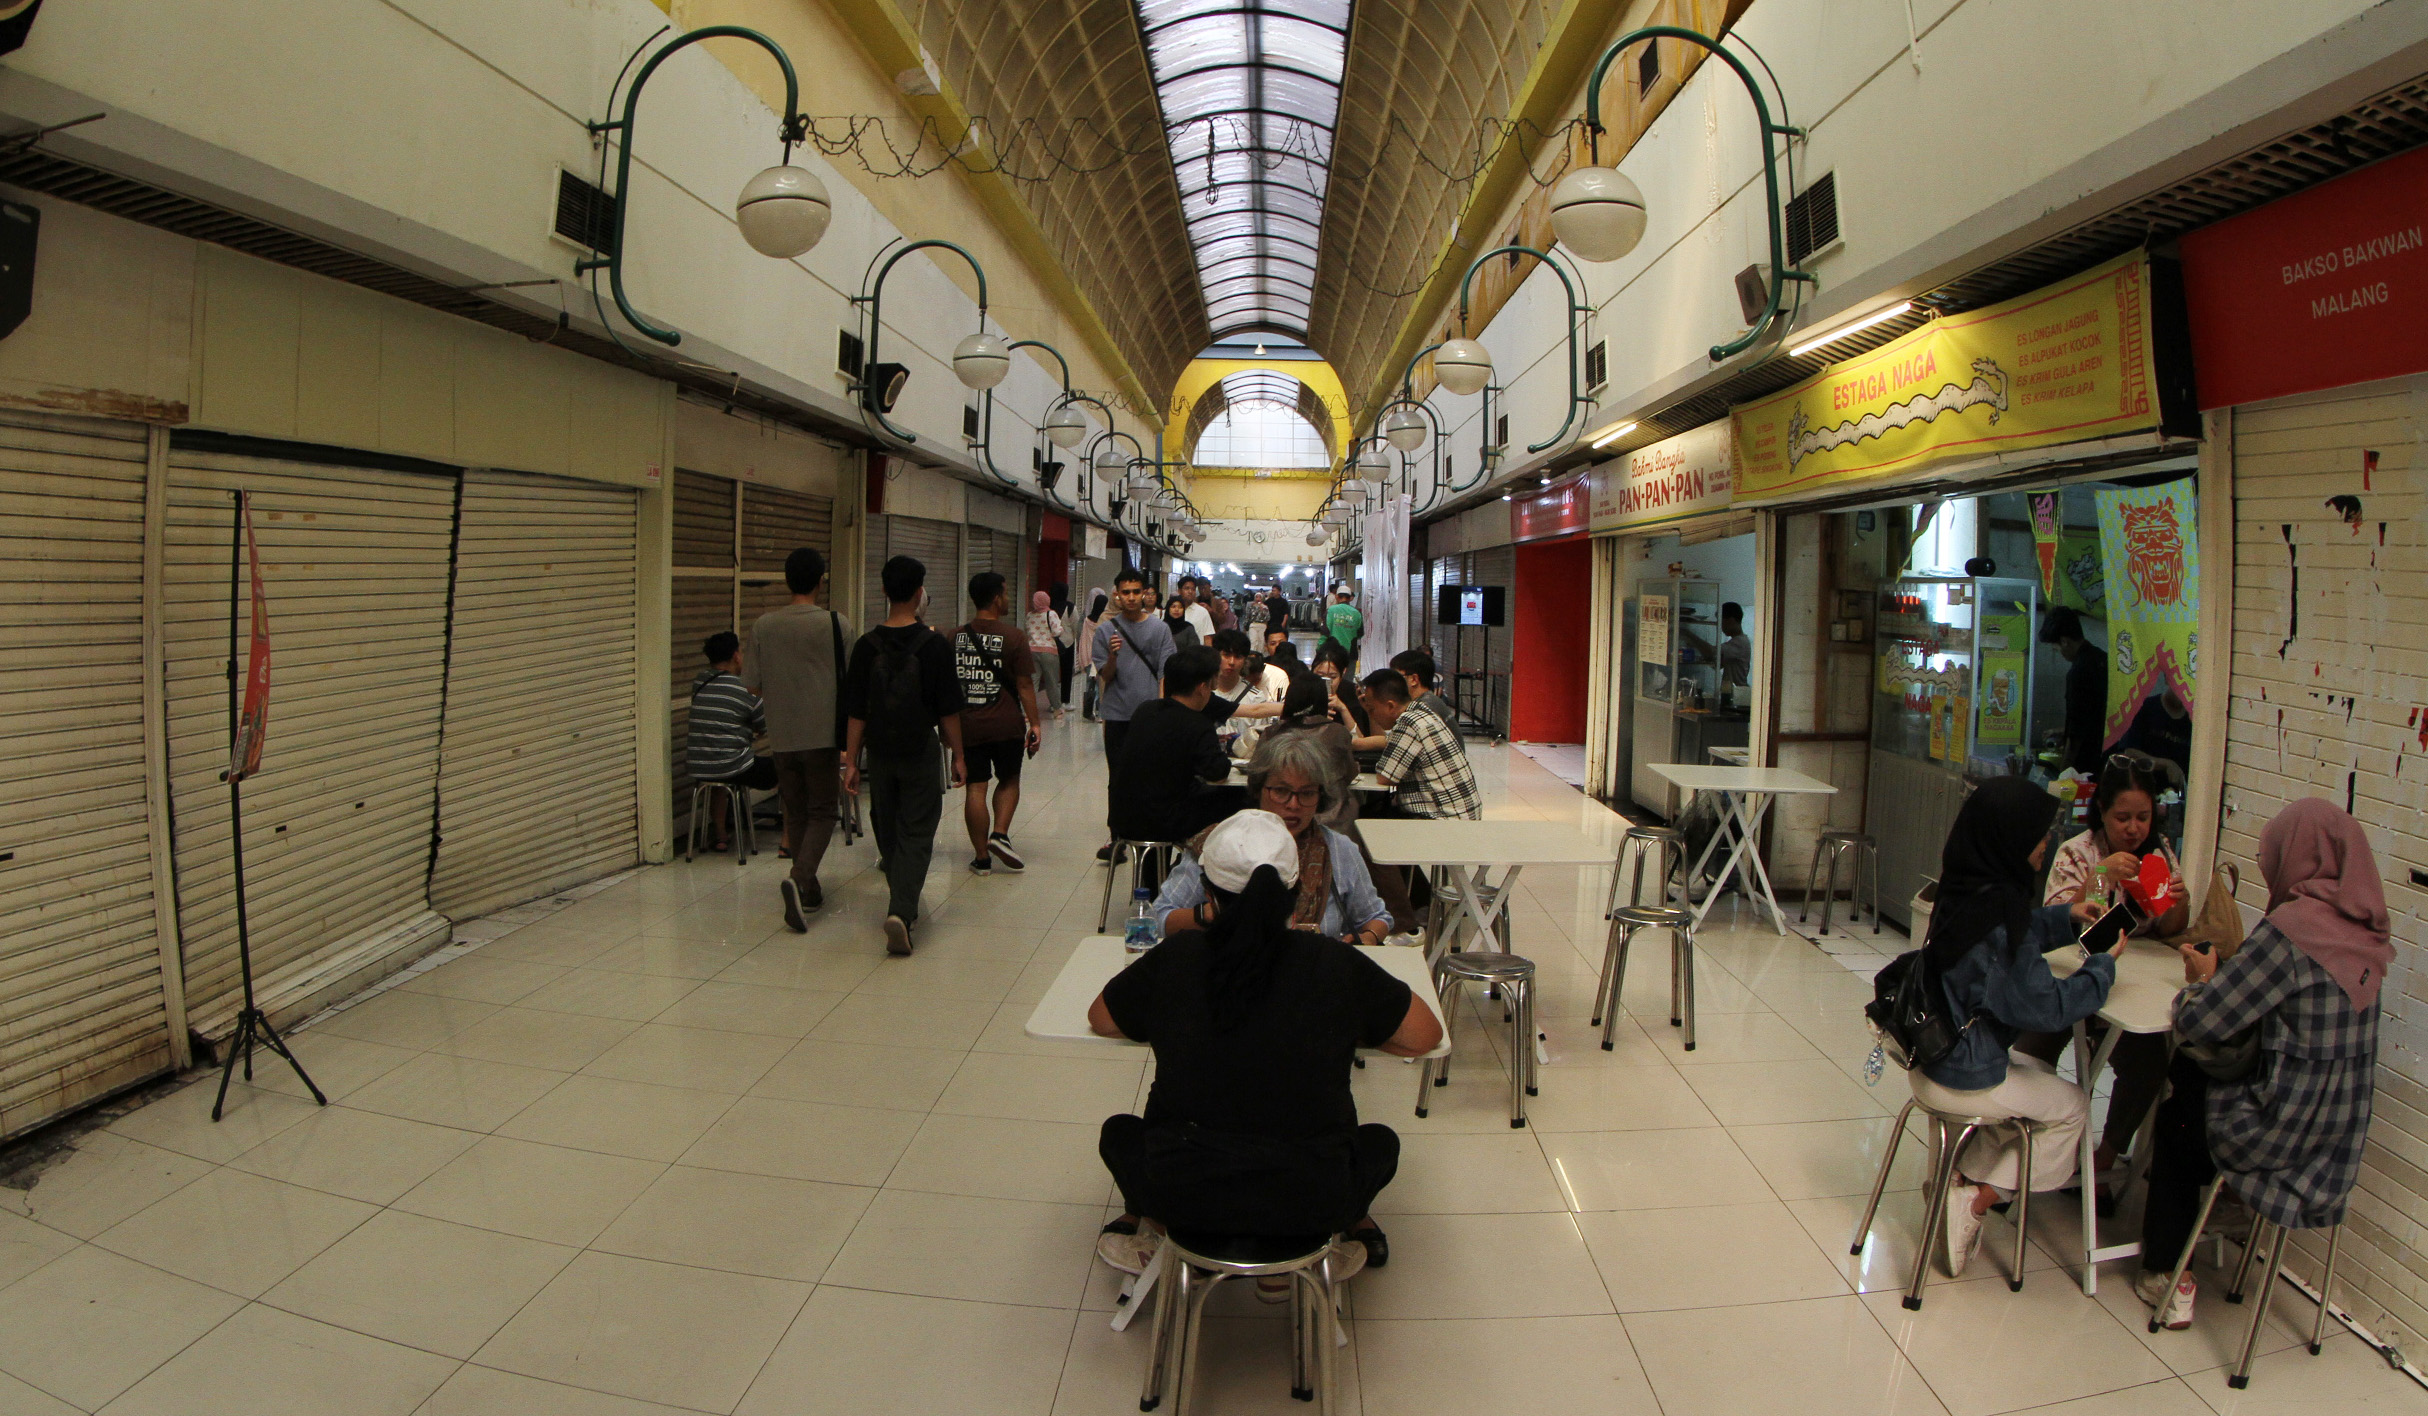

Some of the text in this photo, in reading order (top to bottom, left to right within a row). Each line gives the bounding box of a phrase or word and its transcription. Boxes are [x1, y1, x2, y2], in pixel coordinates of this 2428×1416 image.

[2281, 226, 2423, 285] BAKSO BAKWAN
[2311, 282, 2388, 319] MALANG
[2017, 309, 2099, 347] ES LONGAN JAGUNG
[2019, 331, 2102, 367] ES ALPUKAT KOCOK
[1834, 349, 1937, 410] ESTAGA NAGA
[2016, 355, 2103, 387] ES KRIM GULA AREN
[2021, 380, 2095, 406] ES KRIM KELAPA
[1619, 467, 1704, 515] PAN-PAN-PAN
[1901, 637, 1940, 657] ESTAGA
[956, 666, 994, 683] Being
[1904, 692, 1932, 713] NAGA
